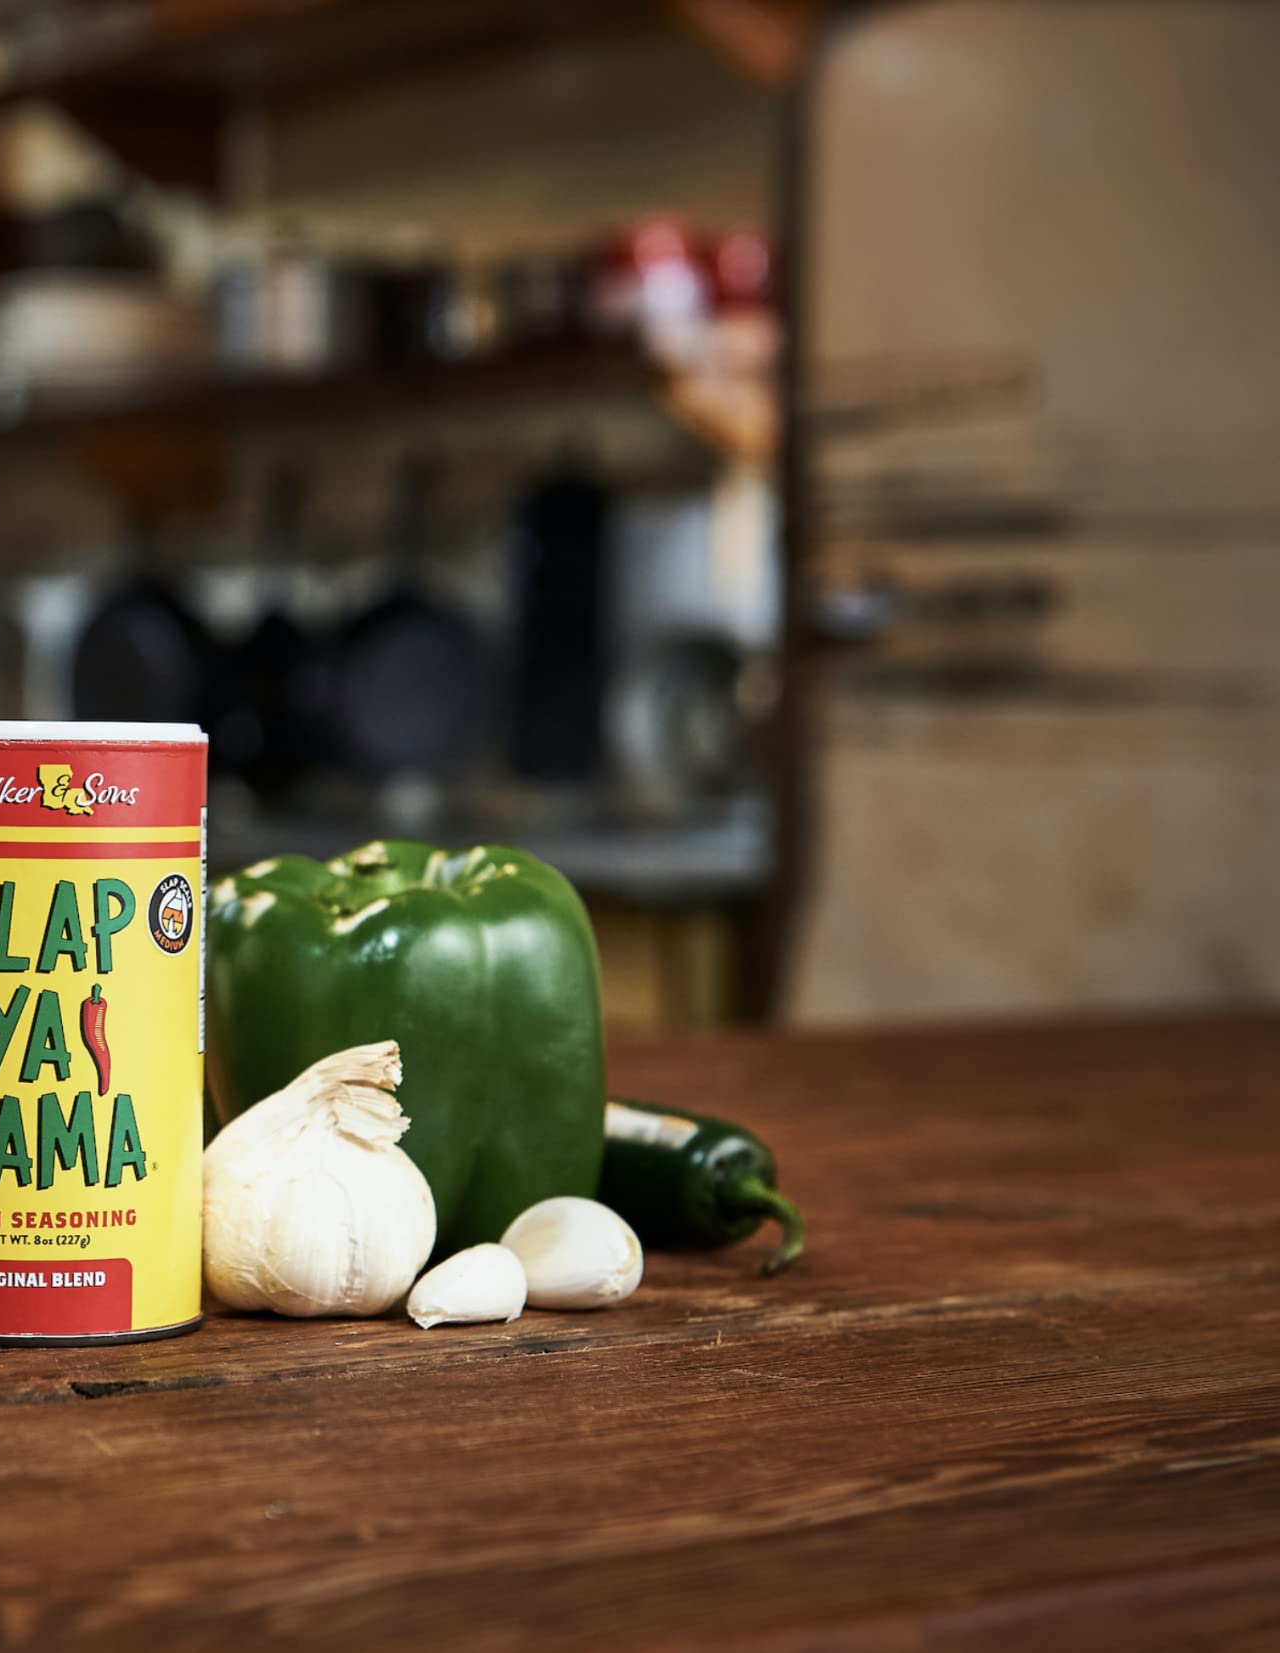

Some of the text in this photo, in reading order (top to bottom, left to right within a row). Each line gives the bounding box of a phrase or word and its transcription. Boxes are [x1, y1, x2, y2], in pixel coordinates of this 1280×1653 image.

[51, 774, 71, 802] &
[75, 772, 140, 807] Sons
[160, 878, 179, 894] SLAP
[154, 929, 185, 950] MEDIUM
[11, 1209, 137, 1229] SEASONING
[10, 1235, 31, 1245] WT.
[34, 1235, 53, 1246] 8oz
[56, 1235, 91, 1248] (227g)
[51, 1271, 106, 1287] BLEND
